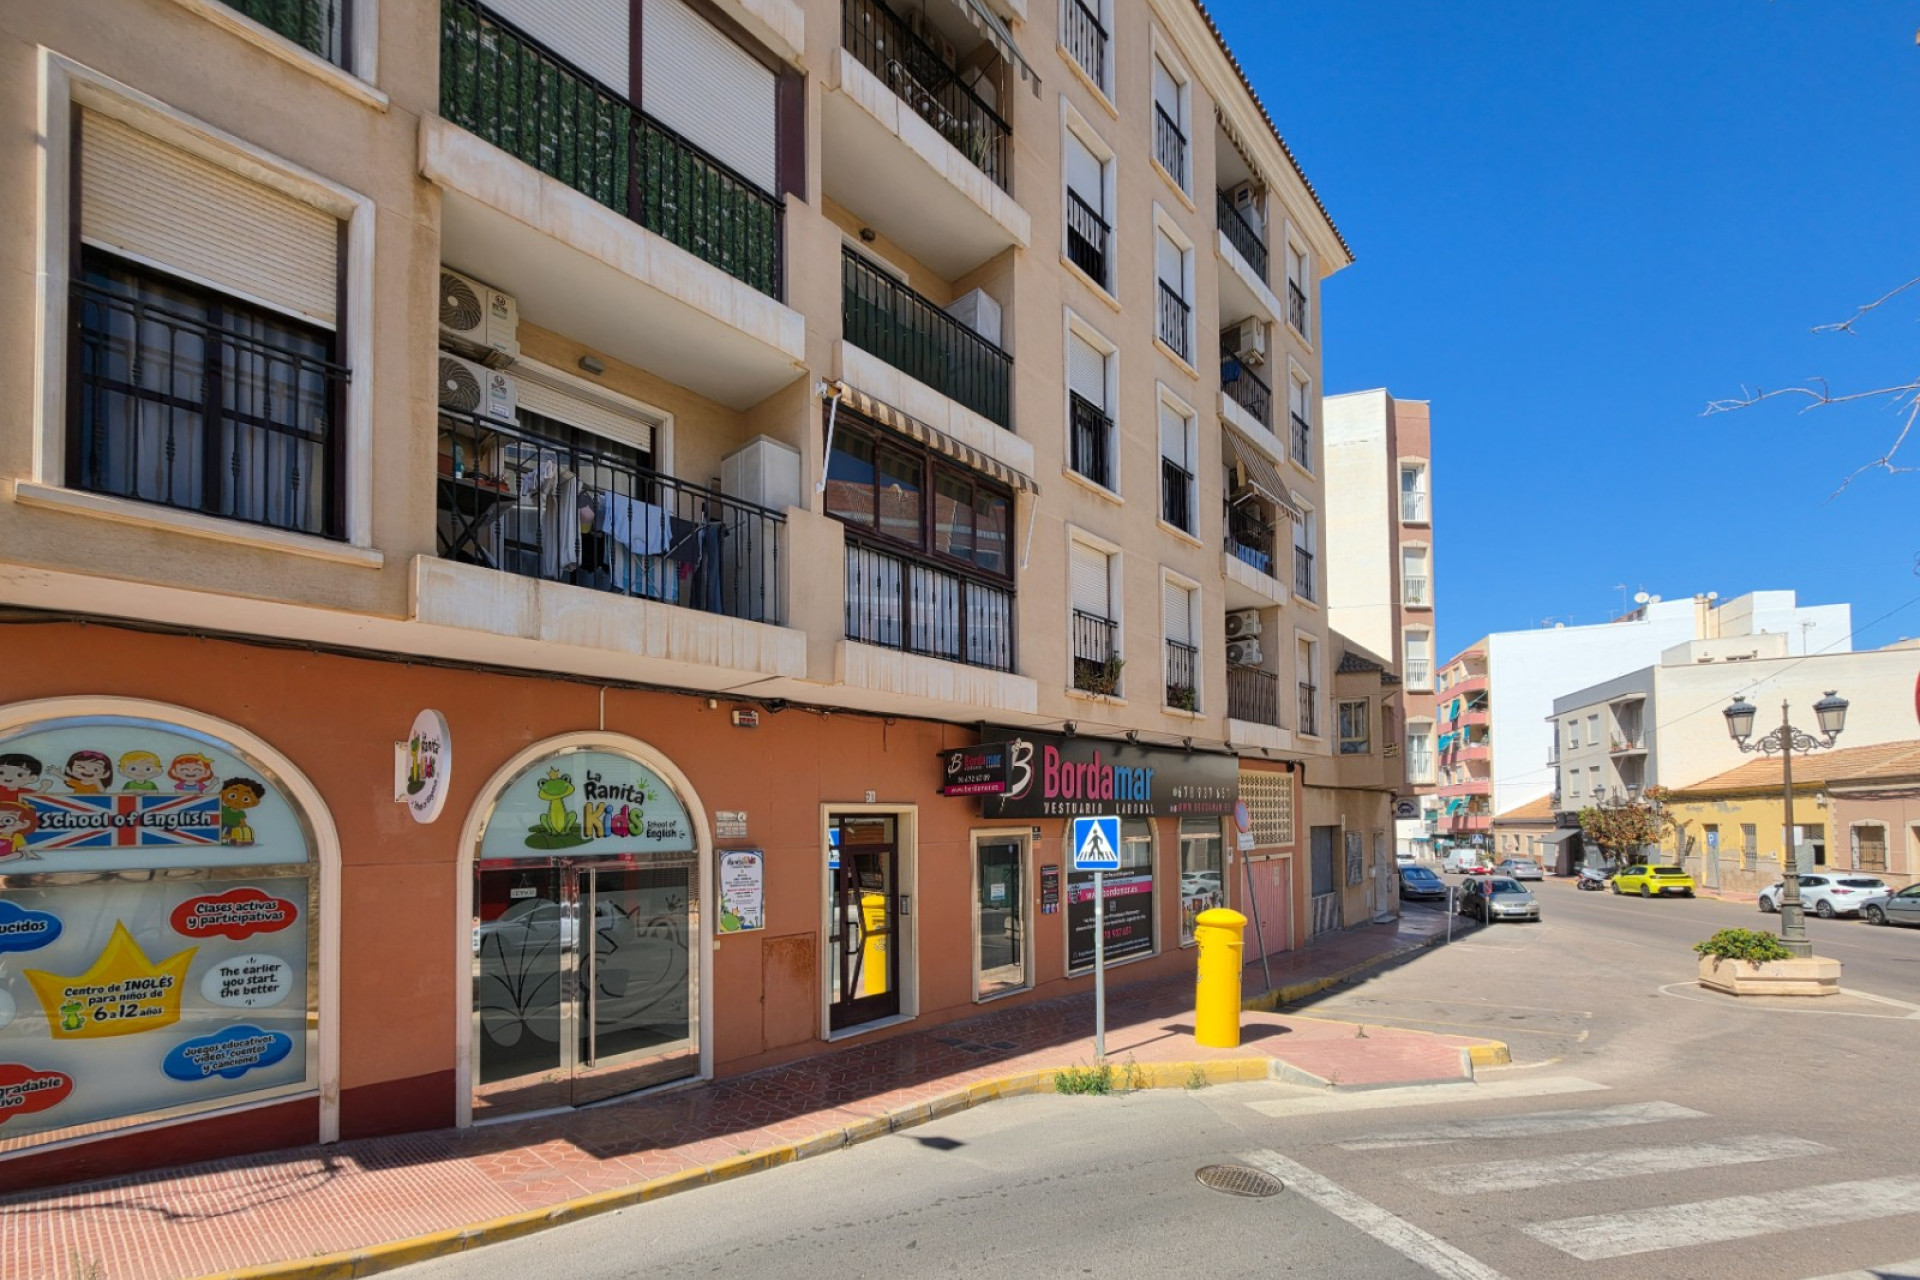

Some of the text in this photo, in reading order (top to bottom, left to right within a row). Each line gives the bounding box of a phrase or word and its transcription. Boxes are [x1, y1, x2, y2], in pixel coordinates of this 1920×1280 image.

[586, 769, 602, 783] La
[1043, 739, 1155, 800] Bordamar
[583, 781, 645, 806] Ranita
[1043, 802, 1155, 815] VESTUARIO LABORAL
[40, 811, 211, 832] School of English
[583, 802, 644, 839] Kids
[646, 829, 677, 842] English
[196, 901, 278, 914] Clases activas
[187, 912, 284, 928] y participativas
[220, 964, 281, 977] The earlier
[65, 976, 173, 996] Centro de INGLÉS
[223, 977, 244, 988] you
[88, 990, 163, 1006] para niños de
[220, 985, 279, 998] the better
[94, 1004, 163, 1021] 6 a 12 años
